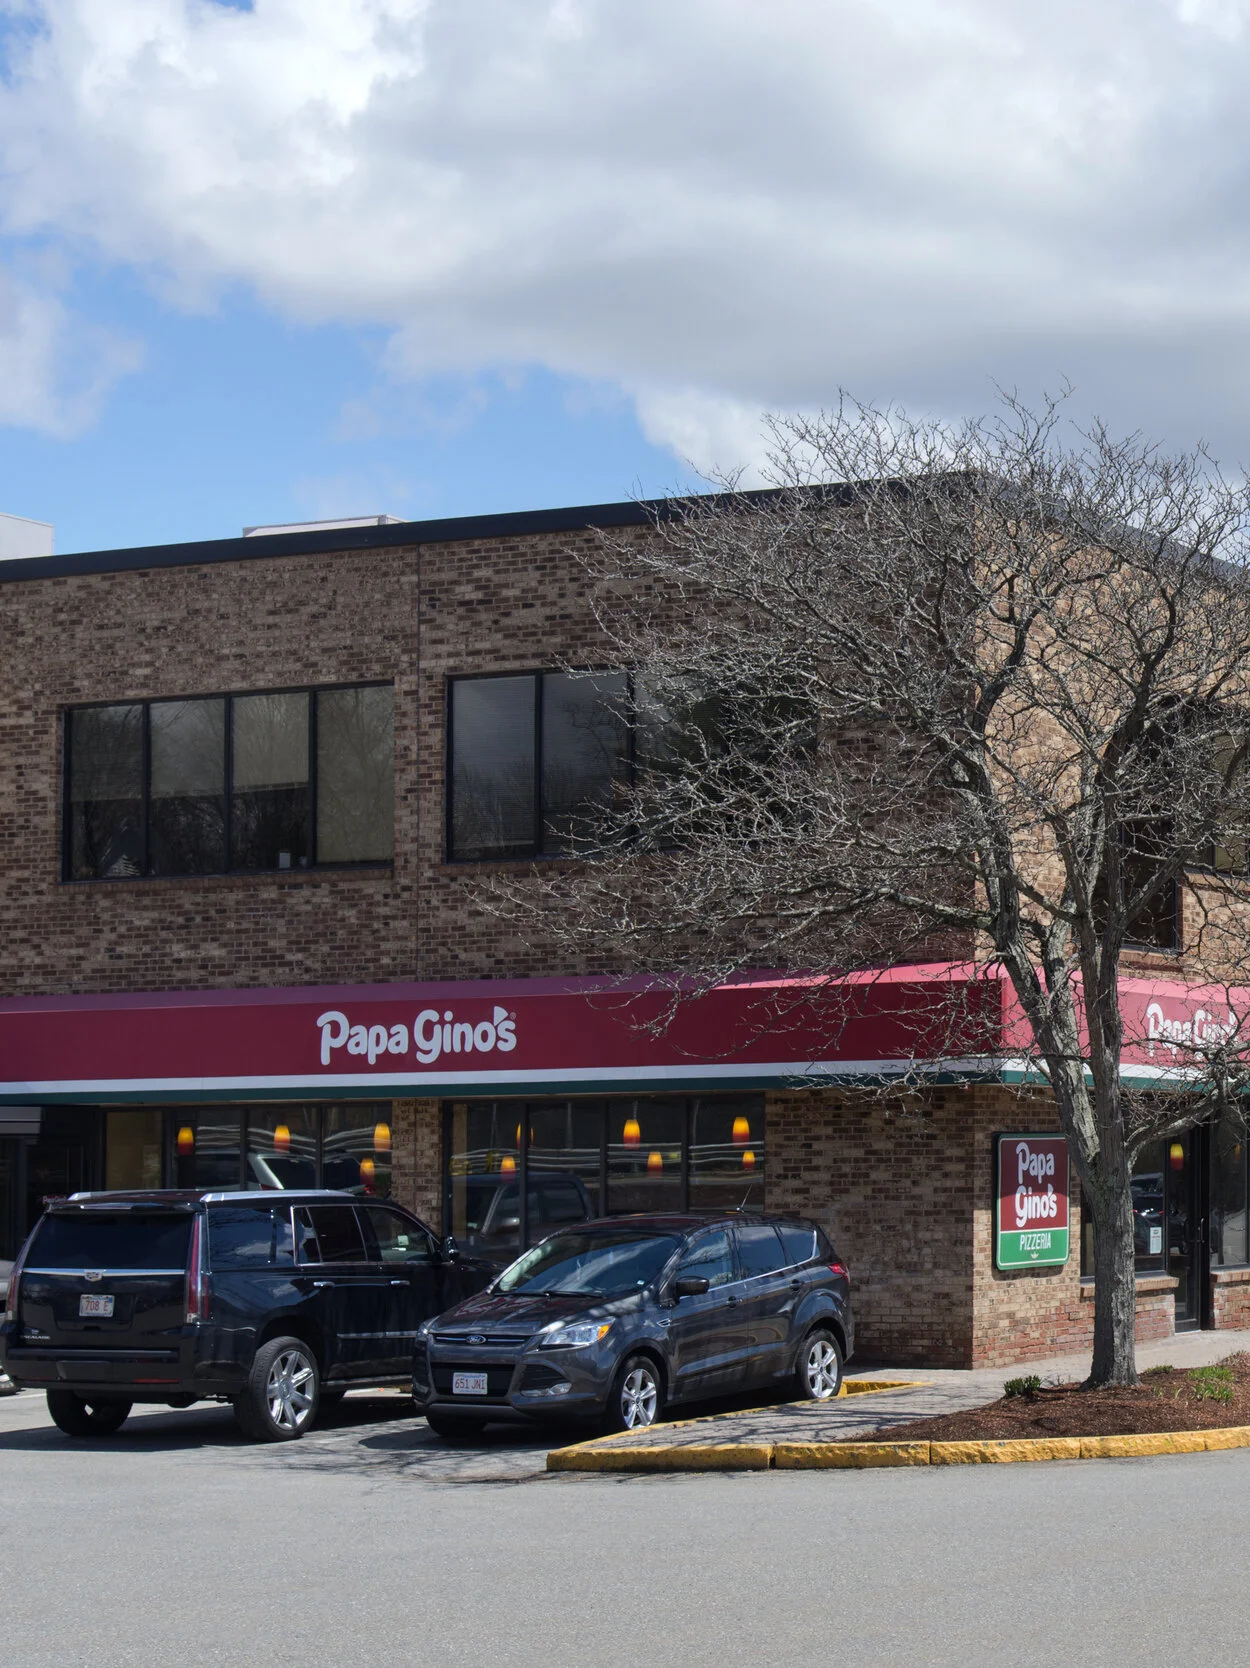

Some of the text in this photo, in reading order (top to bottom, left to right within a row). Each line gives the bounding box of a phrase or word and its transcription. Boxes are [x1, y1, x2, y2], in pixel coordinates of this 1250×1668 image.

[316, 1005, 518, 1066] Papa Gino's
[1015, 1141, 1055, 1185] Papa
[1014, 1183, 1058, 1228] Gino's
[1020, 1232, 1052, 1251] PIZZERIA
